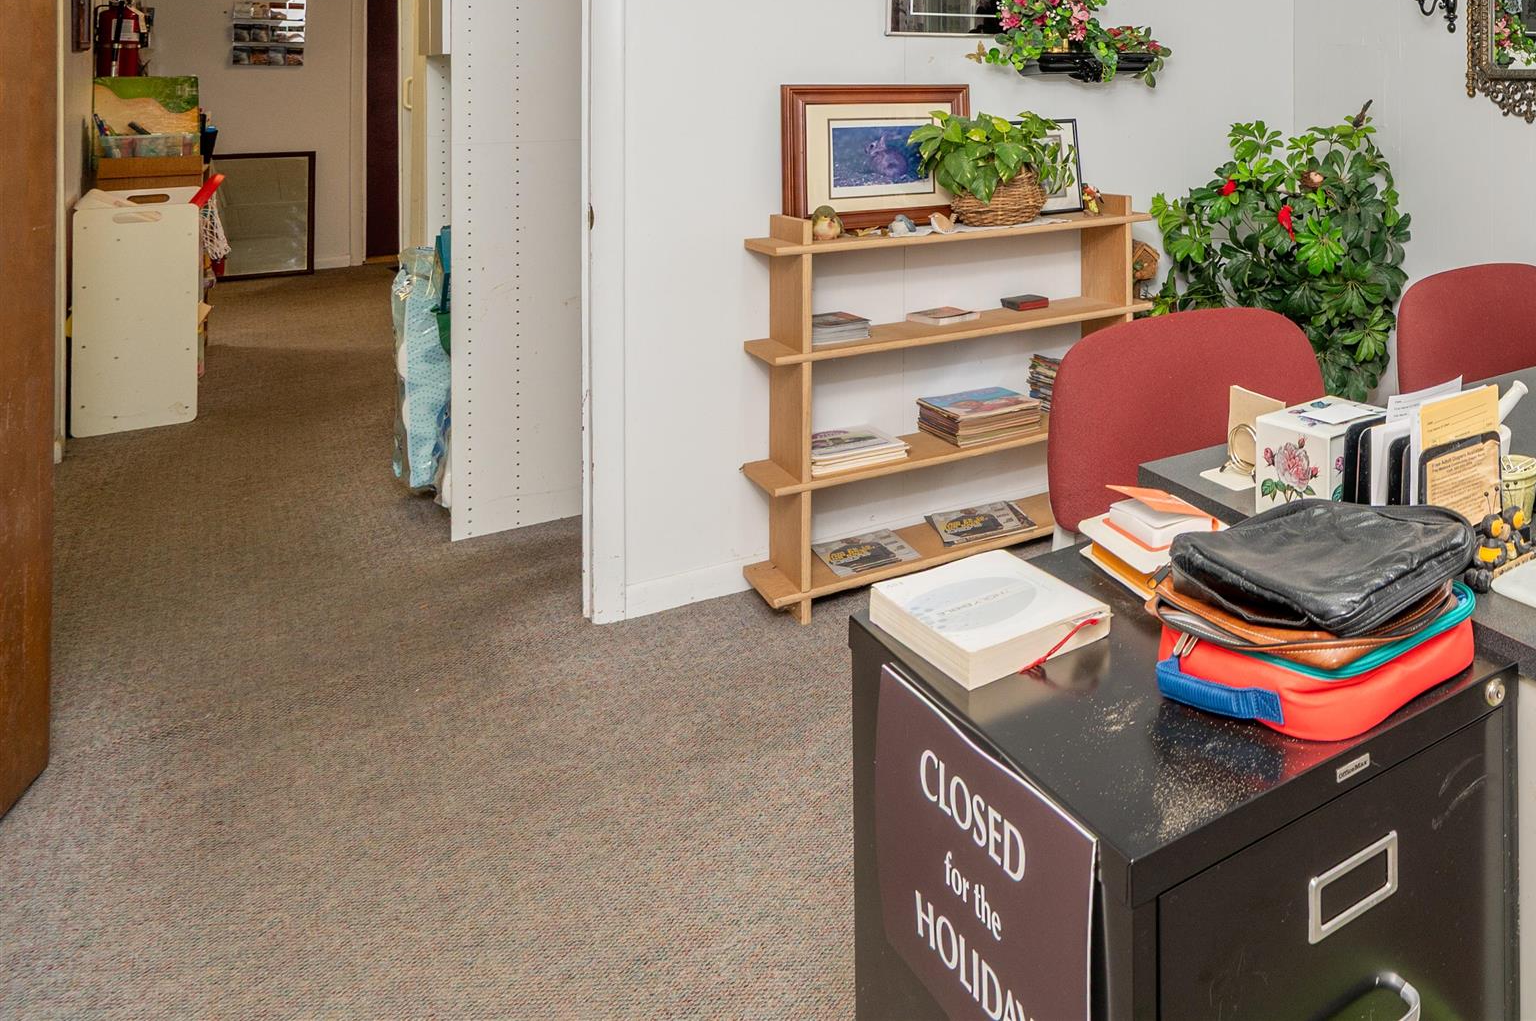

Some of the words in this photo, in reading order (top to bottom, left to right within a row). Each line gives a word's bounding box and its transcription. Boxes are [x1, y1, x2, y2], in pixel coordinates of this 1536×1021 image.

[919, 749, 1026, 882] CLOSED
[915, 889, 1037, 1021] HOLIDA
[943, 850, 970, 903] for
[973, 883, 1002, 941] the
